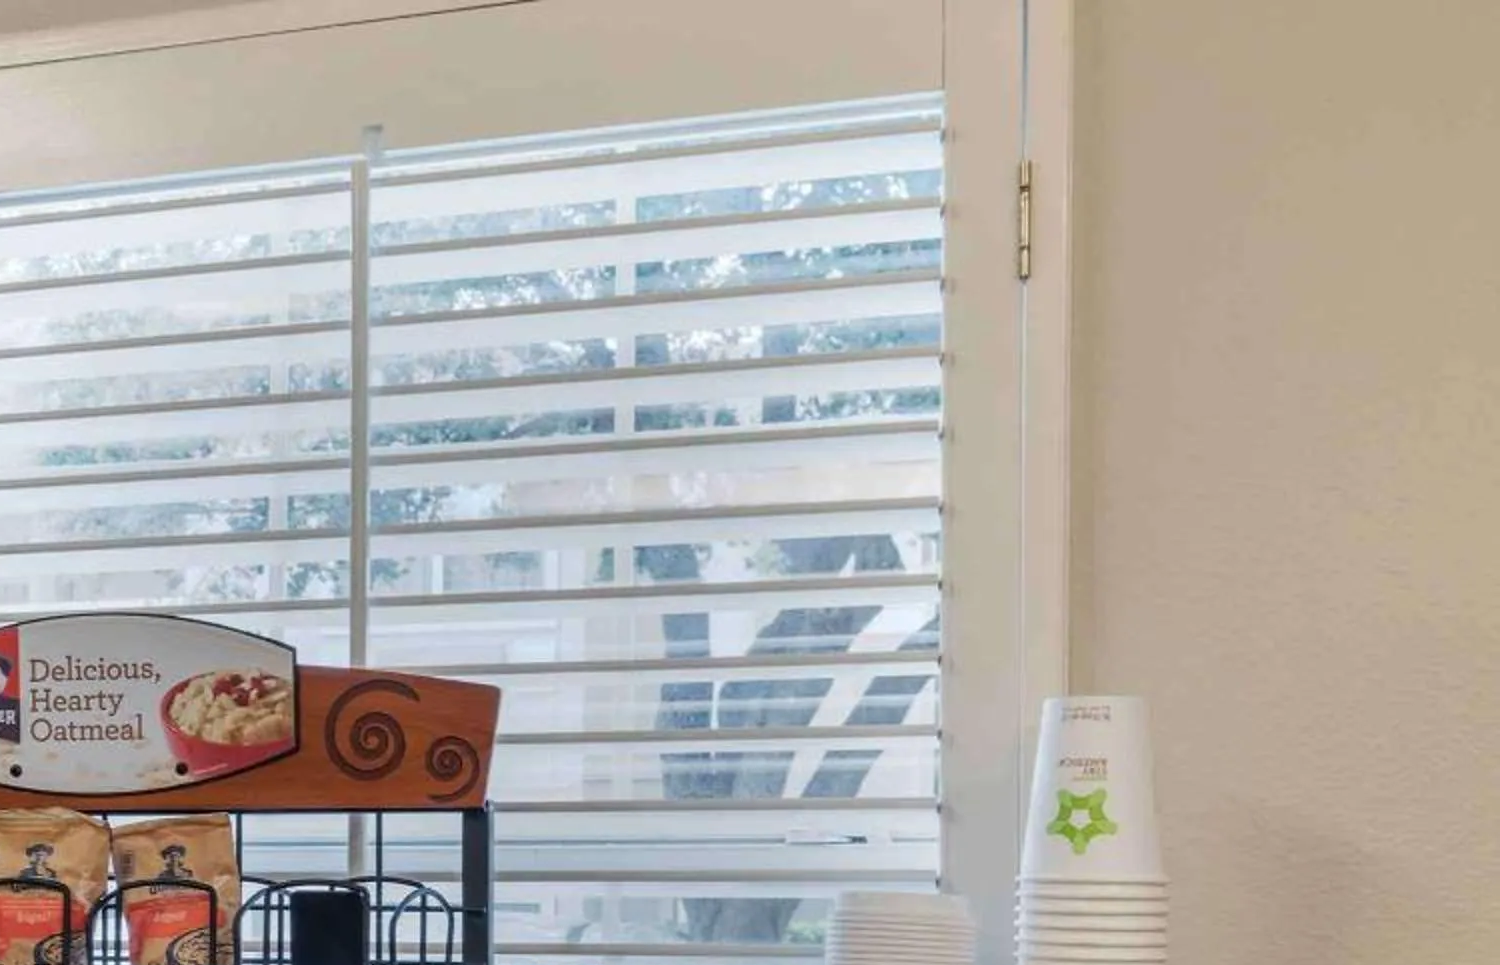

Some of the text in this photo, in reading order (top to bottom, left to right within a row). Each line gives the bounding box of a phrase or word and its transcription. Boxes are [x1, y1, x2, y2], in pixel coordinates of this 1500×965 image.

[29, 655, 162, 684] Delicious,
[29, 688, 124, 716] Hearty
[29, 713, 145, 743] Oatmeal
